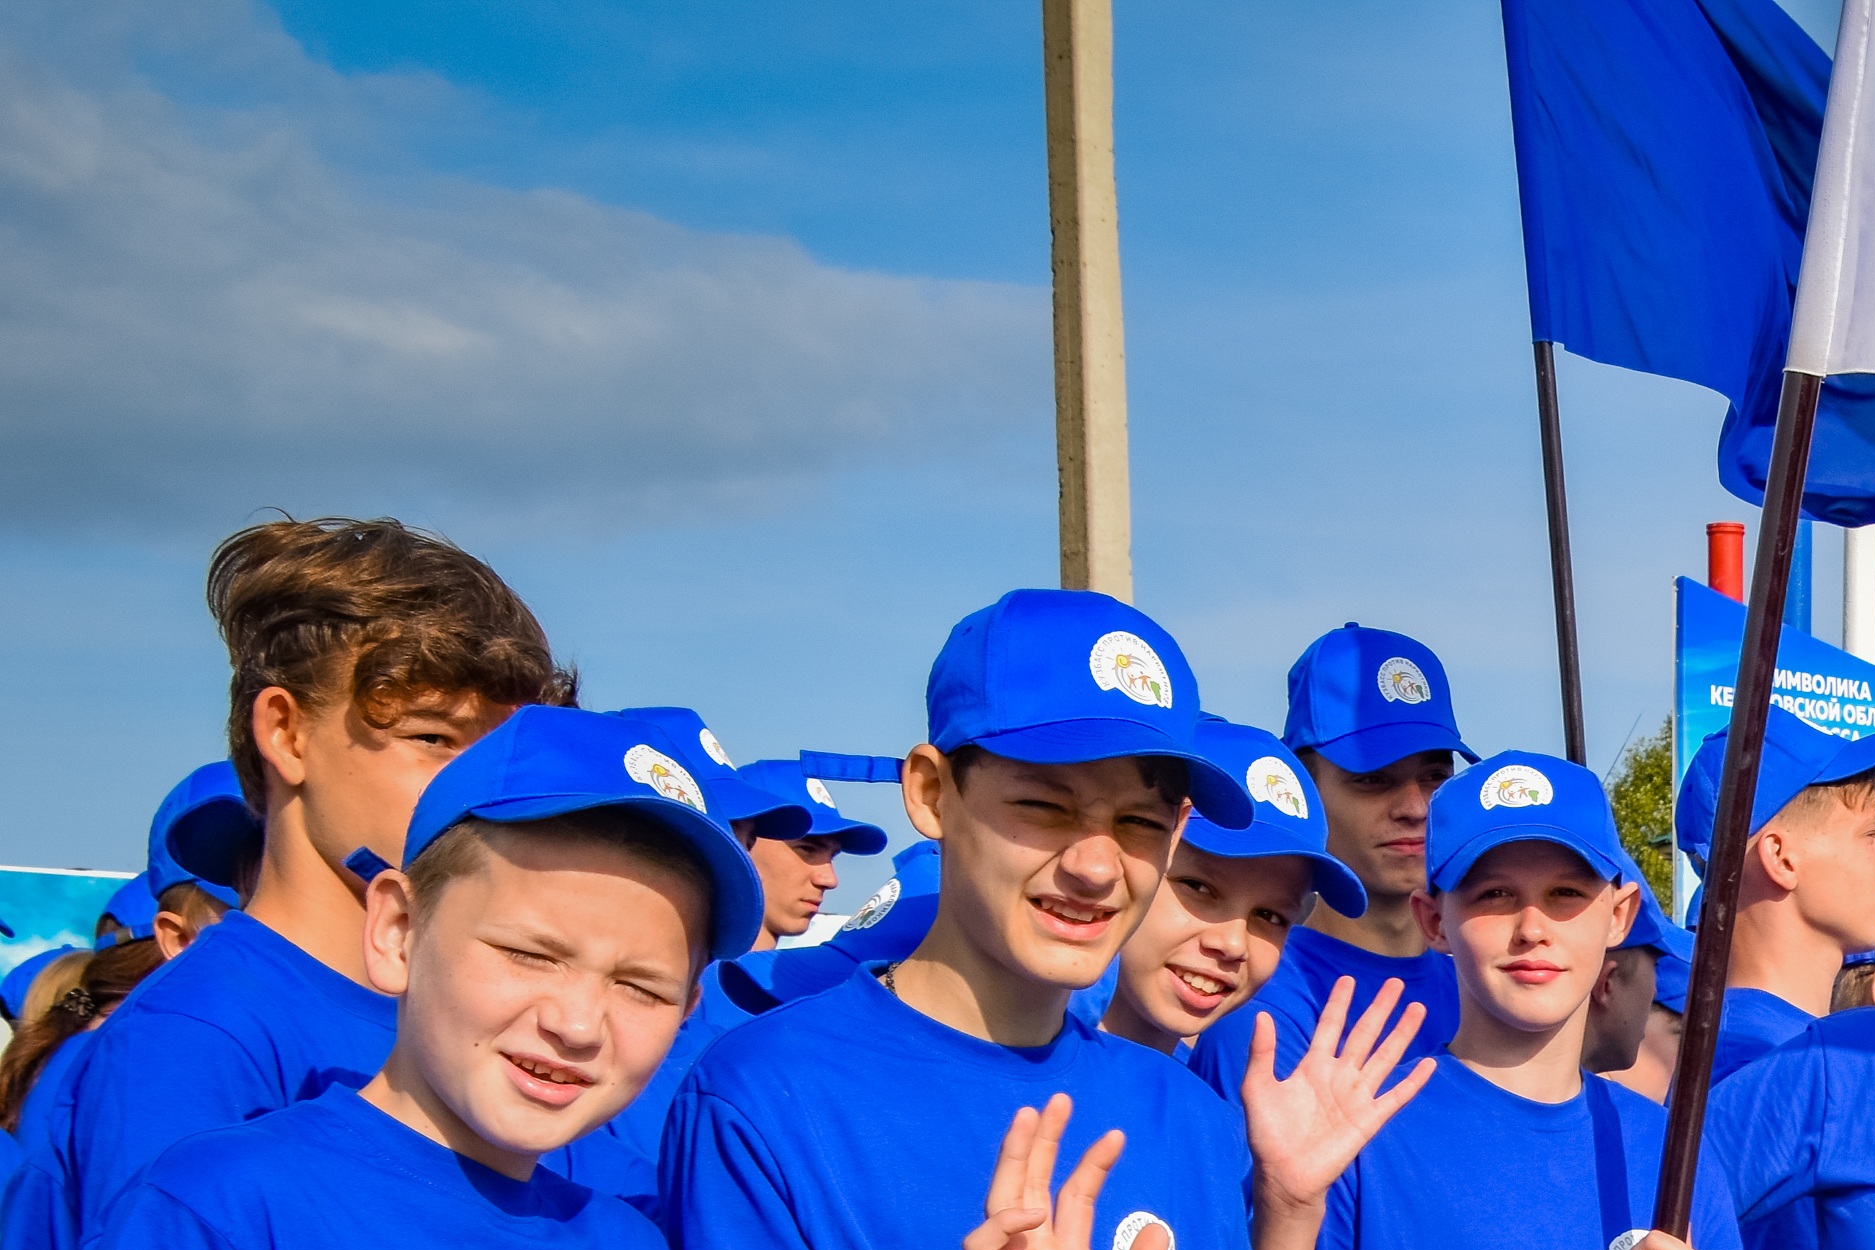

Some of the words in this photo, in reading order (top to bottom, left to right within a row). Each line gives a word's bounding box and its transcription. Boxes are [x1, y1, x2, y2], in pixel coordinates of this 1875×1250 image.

[1093, 646, 1110, 687] КУЗБАСС
[1102, 633, 1138, 647] ПРОТИВ
[1771, 667, 1873, 702] ИМВОЛИКА
